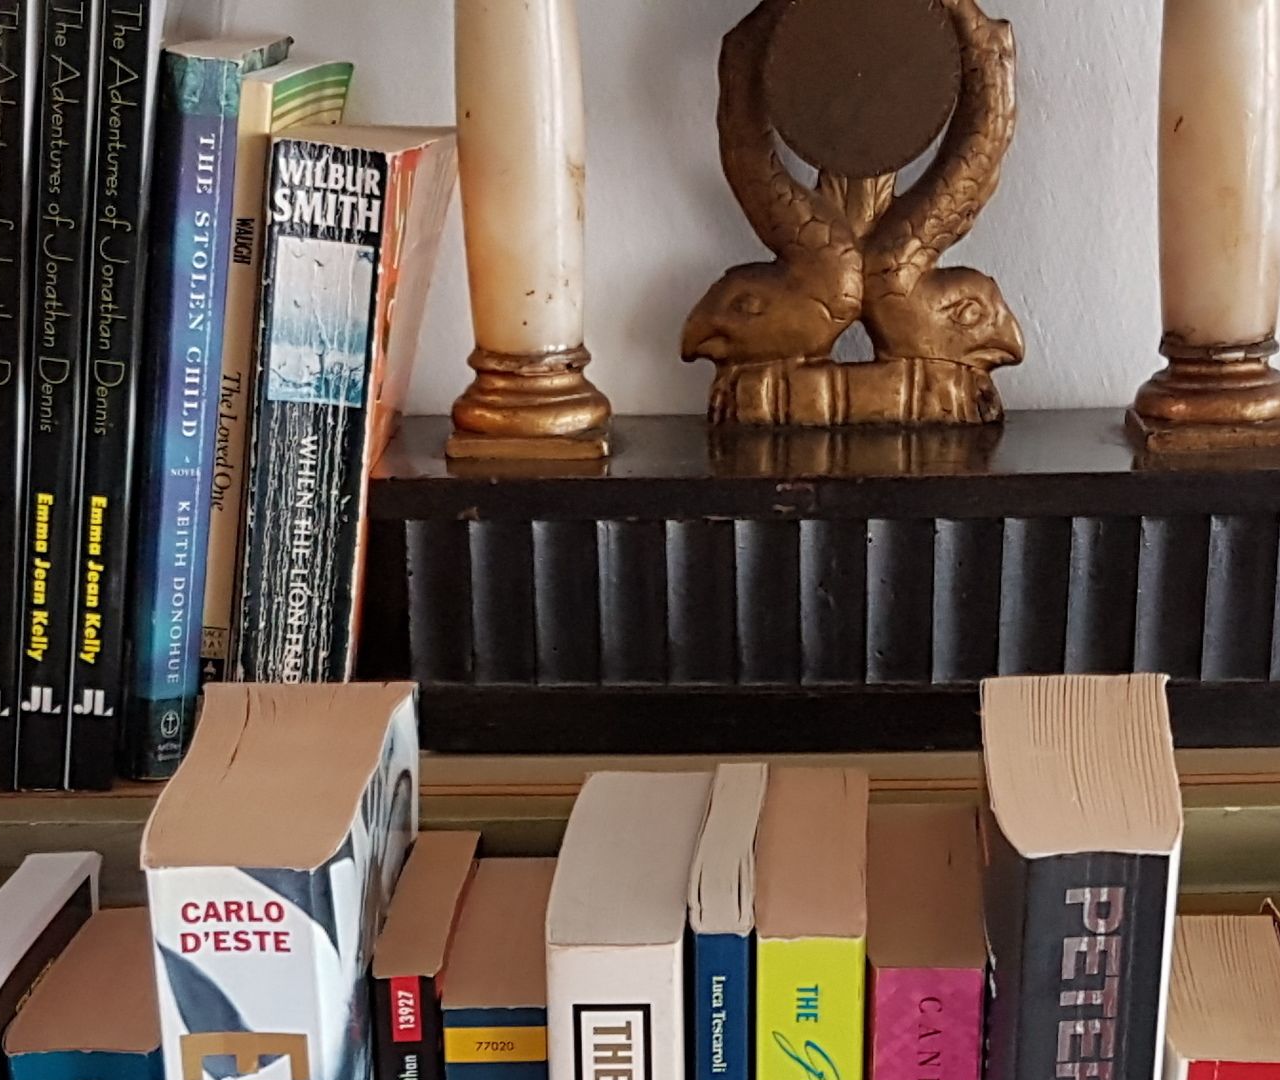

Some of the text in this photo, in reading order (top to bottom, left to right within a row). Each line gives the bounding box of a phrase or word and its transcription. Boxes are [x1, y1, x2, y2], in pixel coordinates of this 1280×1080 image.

[278, 157, 383, 197] WILBUR
[39, 1, 84, 433] The Adventures of Jonathan Dennis
[94, 3, 143, 436] The Adventures of Jonathan Dennis
[274, 188, 380, 233] SMITH
[234, 218, 255, 265] WAUGH
[181, 133, 215, 437] THE STOLEN CHILD
[211, 373, 241, 511] The Loved One
[286, 436, 318, 625] WHEN THE LION
[28, 492, 53, 662] Emma Jean Kelly
[80, 495, 107, 664] Emma Jean Kelly
[167, 501, 190, 683] KEITH DONOHUE
[181, 901, 285, 924] CARLO
[180, 931, 291, 953] D'ESTE
[397, 990, 415, 1030] 13927
[712, 976, 726, 1008] Luca
[796, 983, 819, 1023] THE
[476, 1041, 514, 1051] 77020
[712, 1011, 727, 1072] Tescaroli
